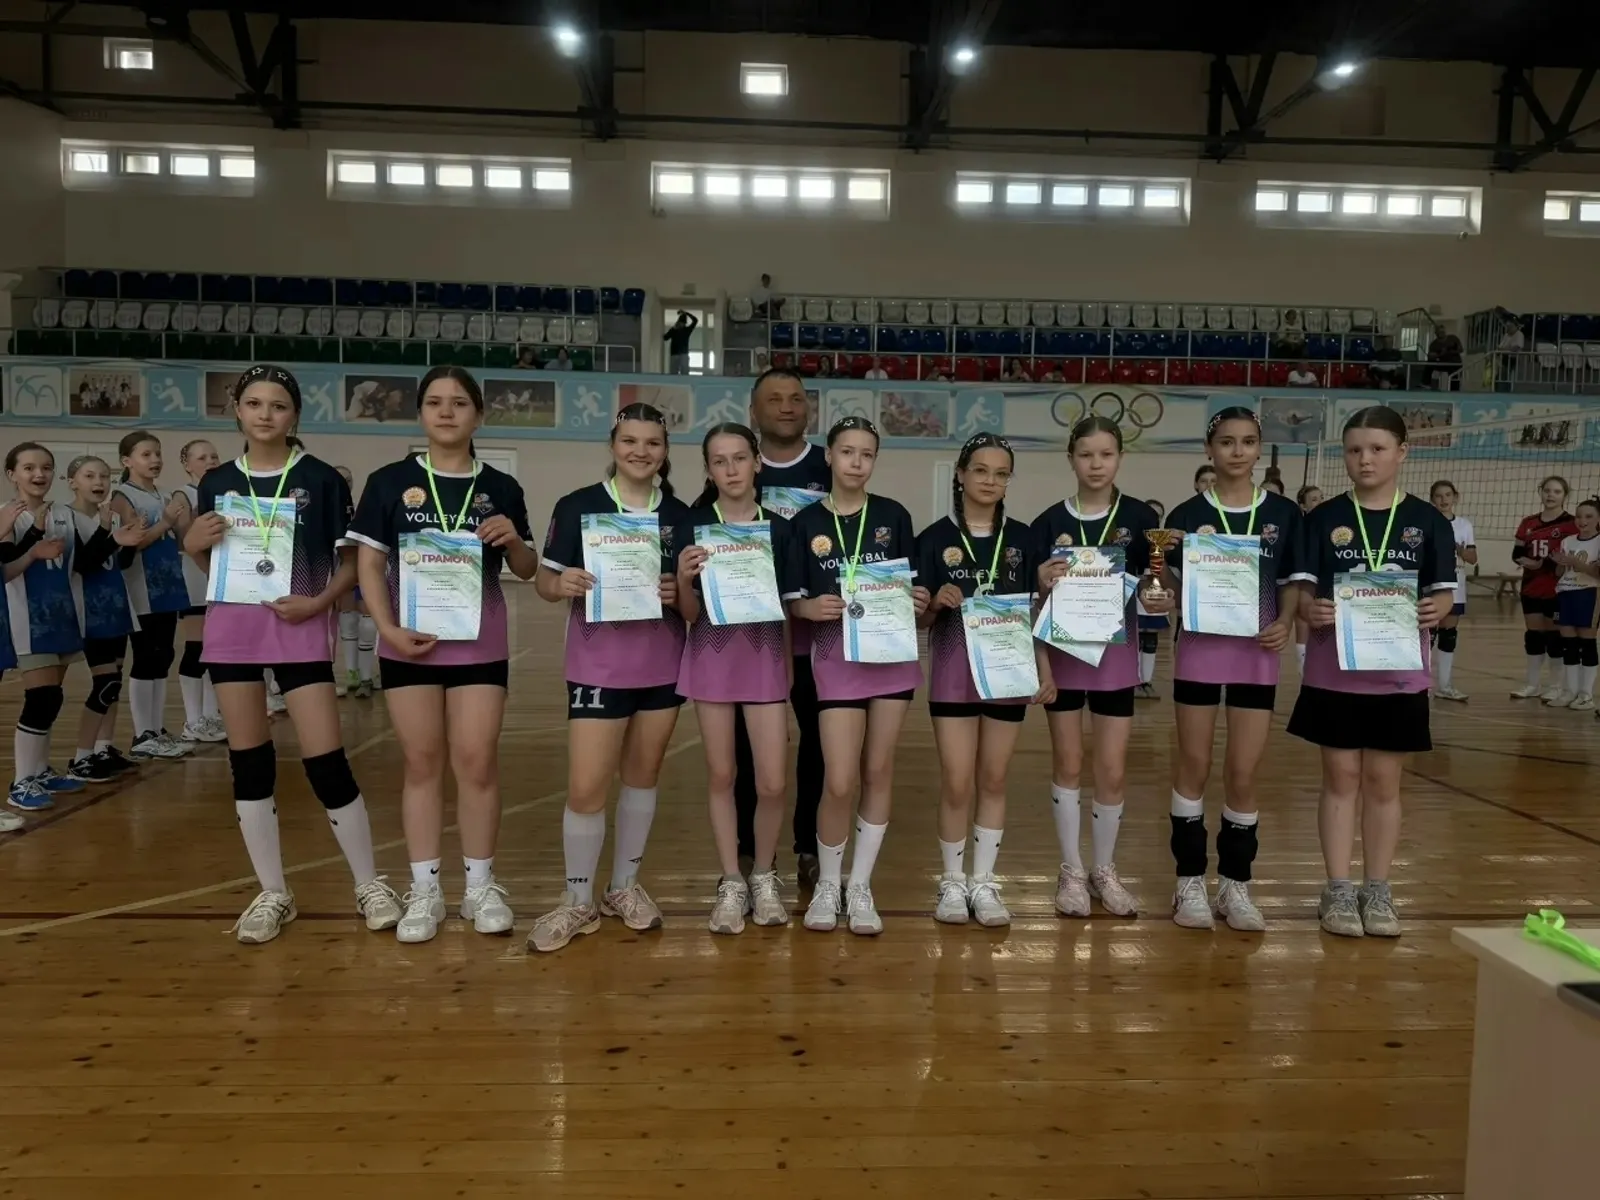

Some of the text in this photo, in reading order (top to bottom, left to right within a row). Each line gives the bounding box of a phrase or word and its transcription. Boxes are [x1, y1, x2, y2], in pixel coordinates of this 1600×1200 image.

[405, 512, 481, 526] VOLLEYBAL
[603, 534, 652, 544] ГРАМОТА
[1532, 540, 1548, 558] 15
[422, 554, 473, 563] ГРАМОТА
[1356, 587, 1409, 597] ГРАМОТА
[571, 686, 604, 708] 11
